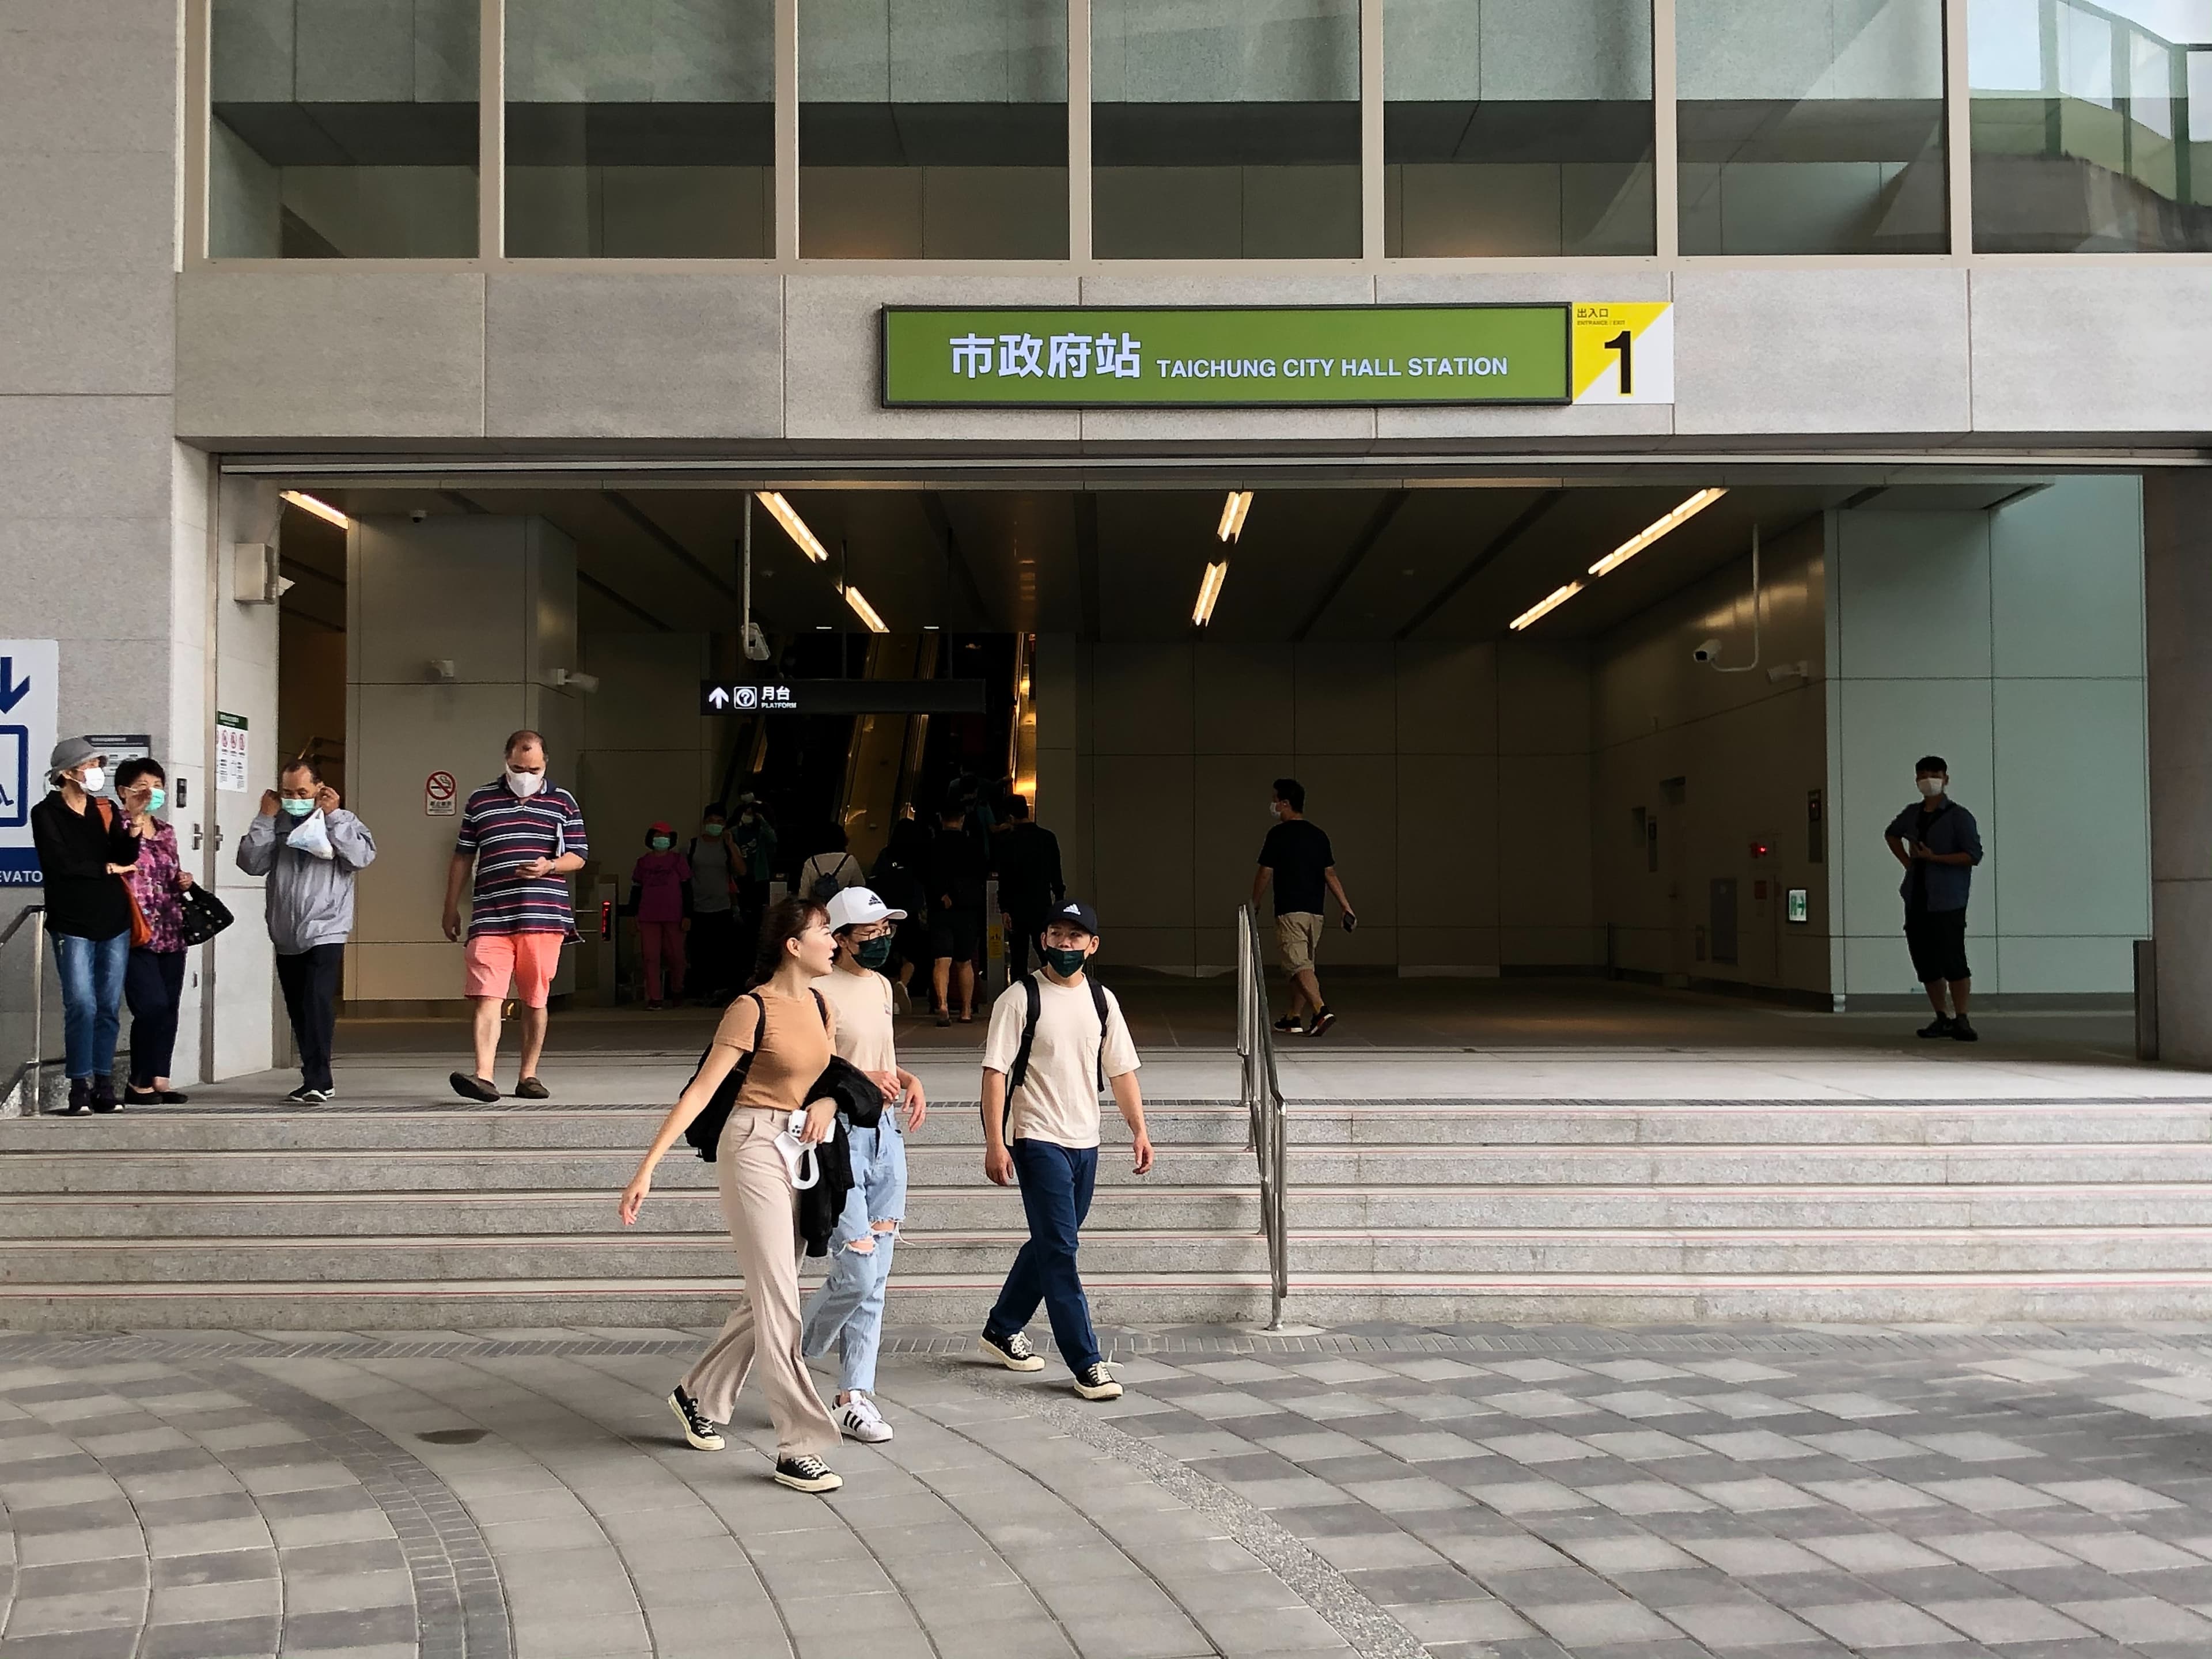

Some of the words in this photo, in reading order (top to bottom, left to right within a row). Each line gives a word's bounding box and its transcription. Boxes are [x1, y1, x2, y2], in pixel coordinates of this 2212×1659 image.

[1577, 308, 1609, 318] 出入口
[949, 332, 1141, 378] 市政府站
[1604, 331, 1631, 394] 1
[1156, 359, 1277, 378] TAICHUNG
[1283, 358, 1335, 377] CITY
[1341, 358, 1402, 377] HALL
[1408, 357, 1508, 376] STATION
[761, 685, 790, 700] 月台
[0, 870, 43, 882] VATO
